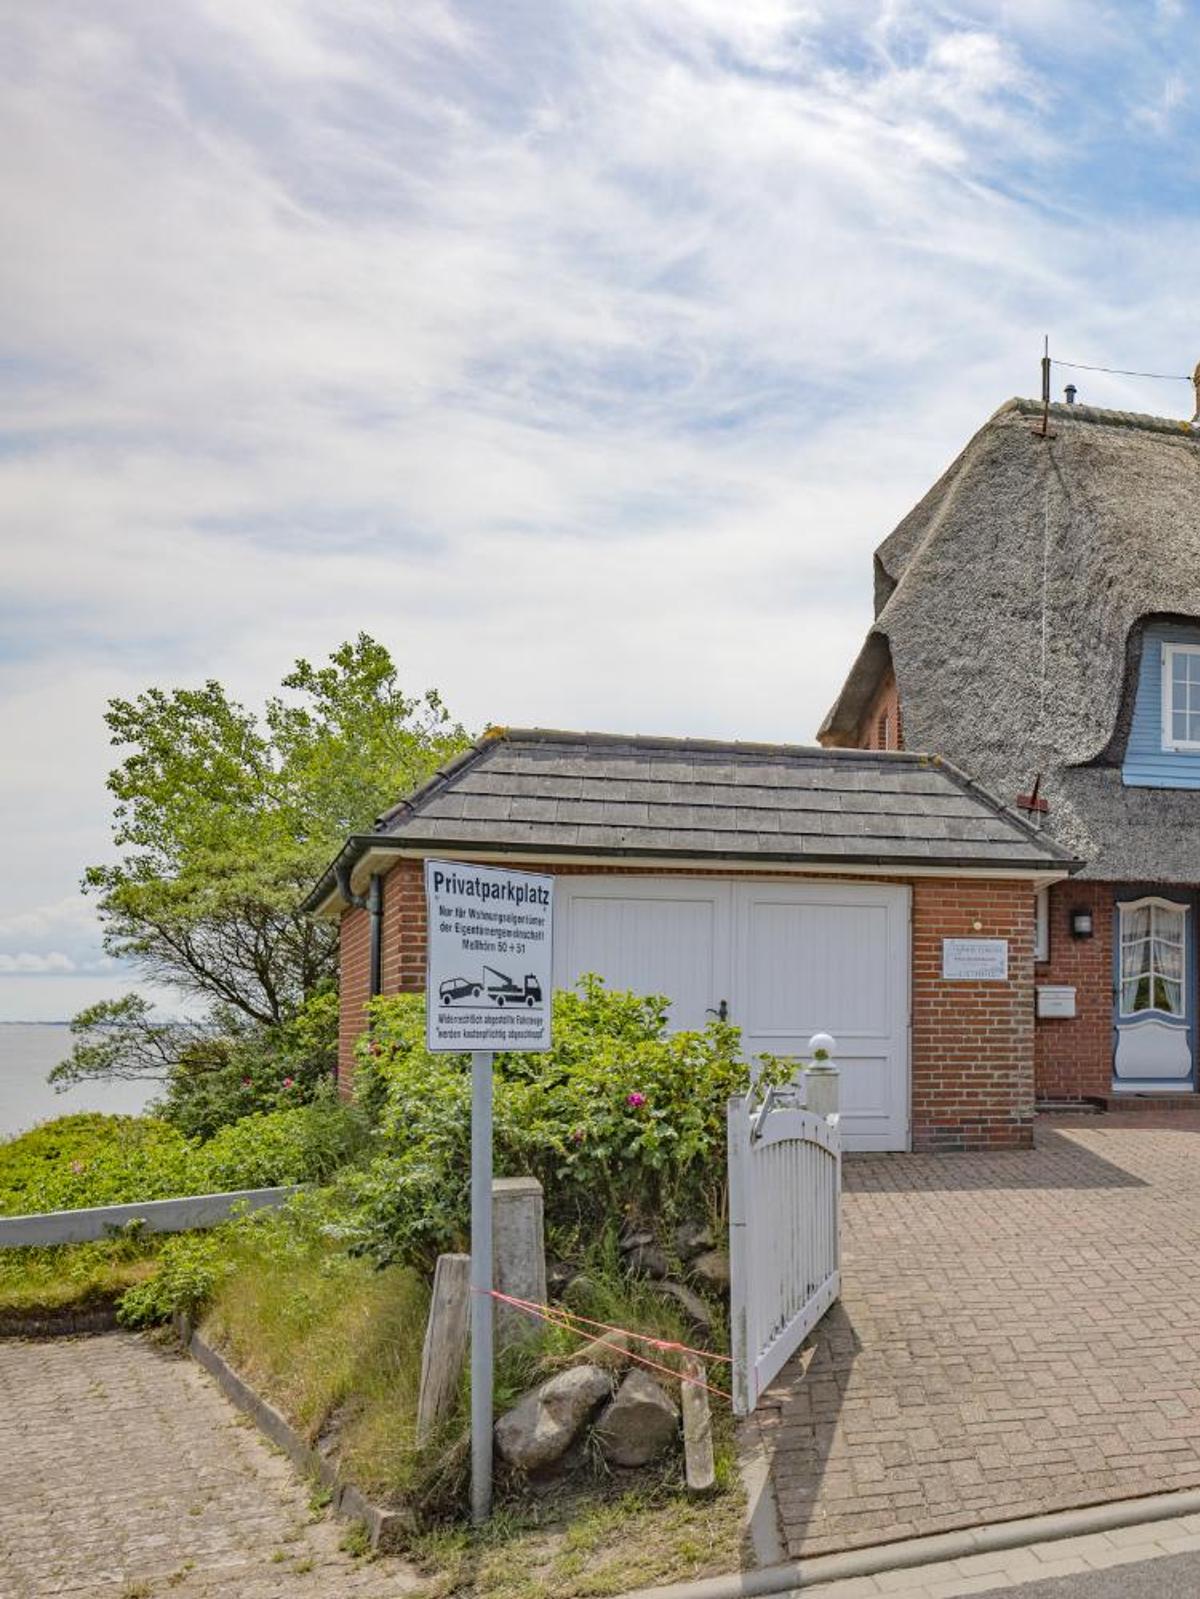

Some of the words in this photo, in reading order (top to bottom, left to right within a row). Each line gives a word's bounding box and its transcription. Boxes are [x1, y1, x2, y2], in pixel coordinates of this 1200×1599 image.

[434, 871, 549, 906] Privatparkplatz
[439, 905, 453, 917] Nur
[455, 907, 466, 919] für
[439, 921, 452, 933] der
[497, 941, 507, 952] 50
[516, 943, 525, 953] 51
